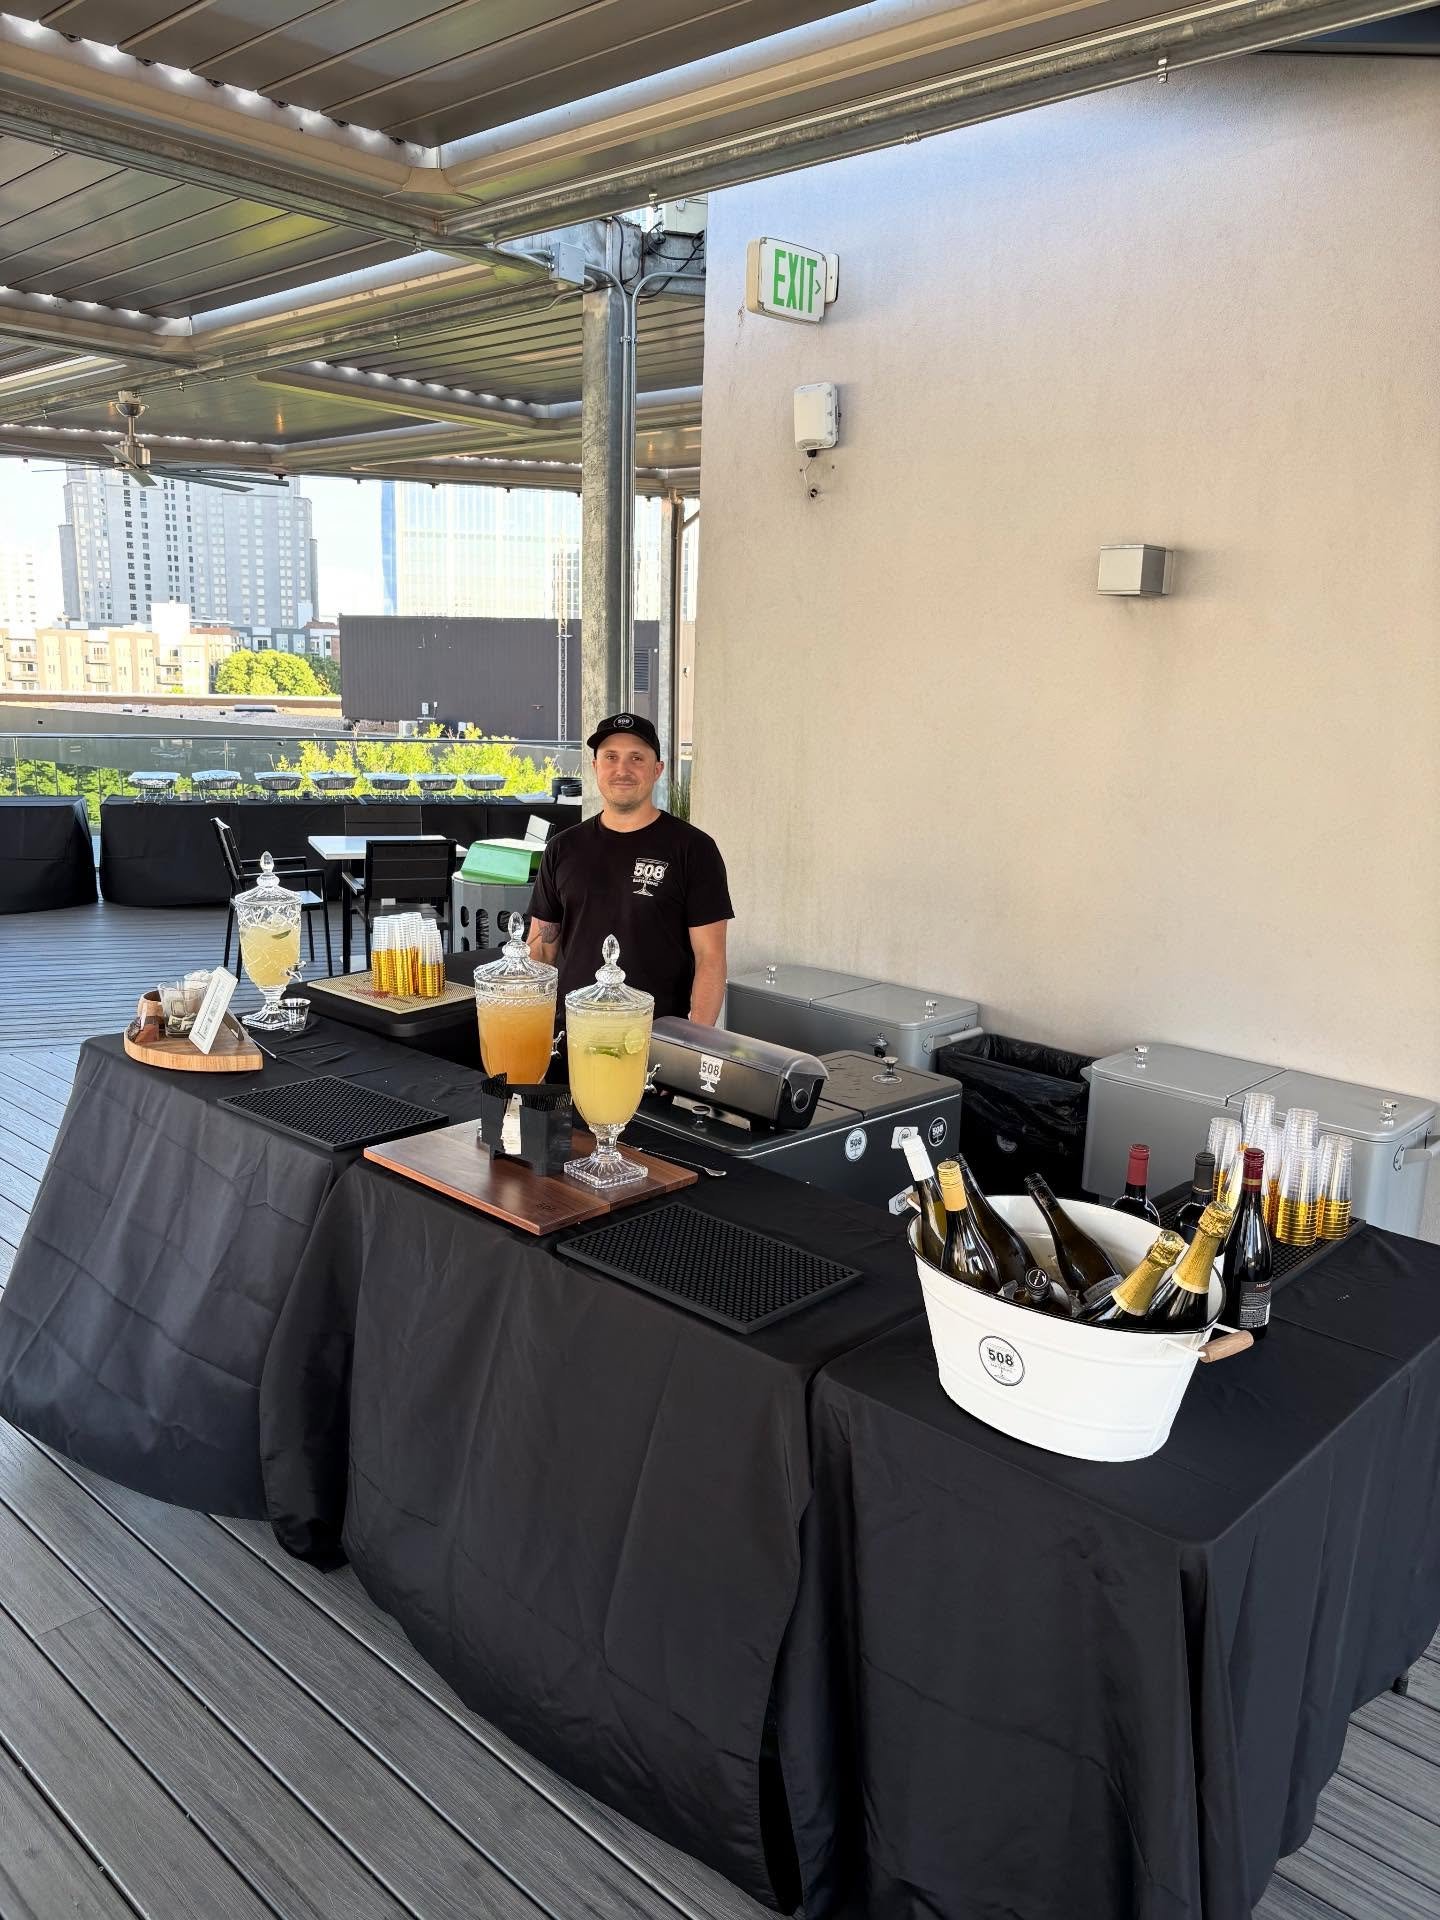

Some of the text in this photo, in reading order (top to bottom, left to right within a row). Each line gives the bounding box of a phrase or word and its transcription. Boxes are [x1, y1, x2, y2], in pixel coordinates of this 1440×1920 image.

[773, 248, 817, 313] EXIT
[634, 863, 665, 880] 508
[701, 1061, 720, 1077] 508
[932, 1124, 944, 1136] 508
[850, 1137, 862, 1148] 508
[988, 1348, 1014, 1366] 508
